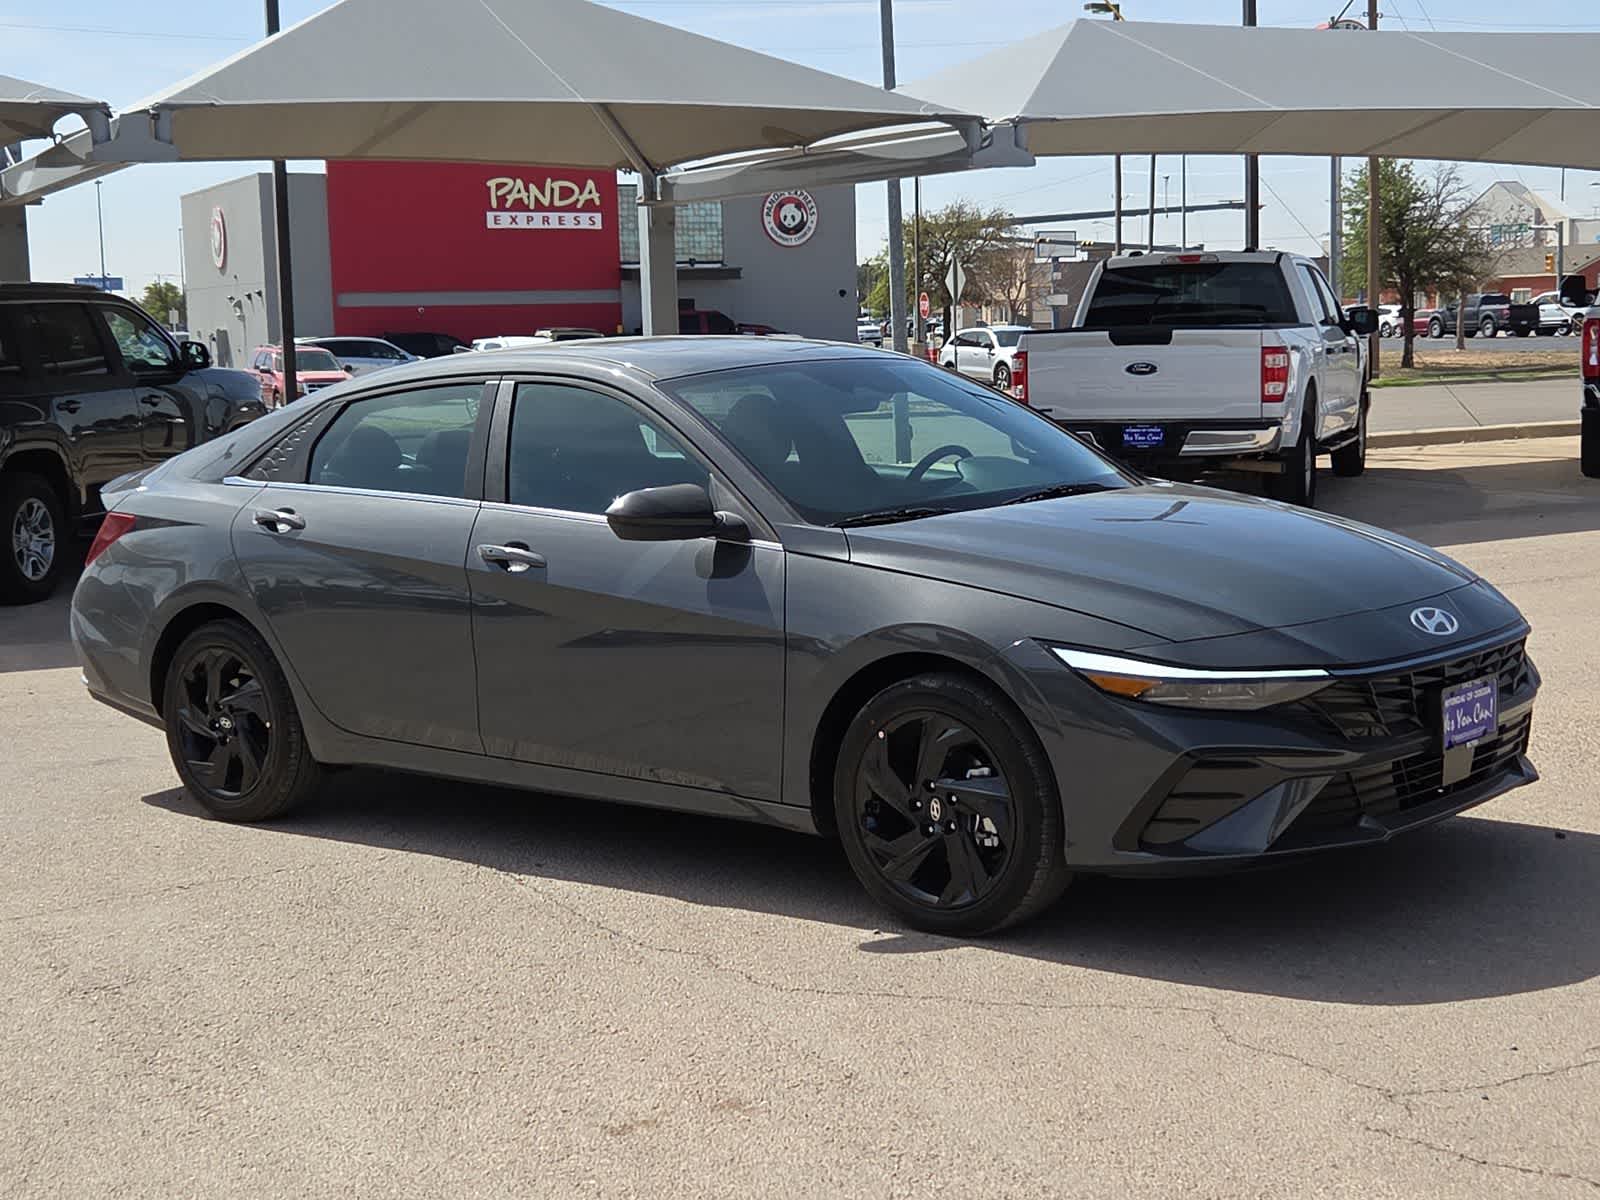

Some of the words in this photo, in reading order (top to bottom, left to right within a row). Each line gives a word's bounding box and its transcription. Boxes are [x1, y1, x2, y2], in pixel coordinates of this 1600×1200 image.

[486, 178, 600, 209] PANDA
[493, 215, 596, 226] EXPRESS
[1457, 708, 1473, 728] You
[1473, 697, 1493, 723] Can!
